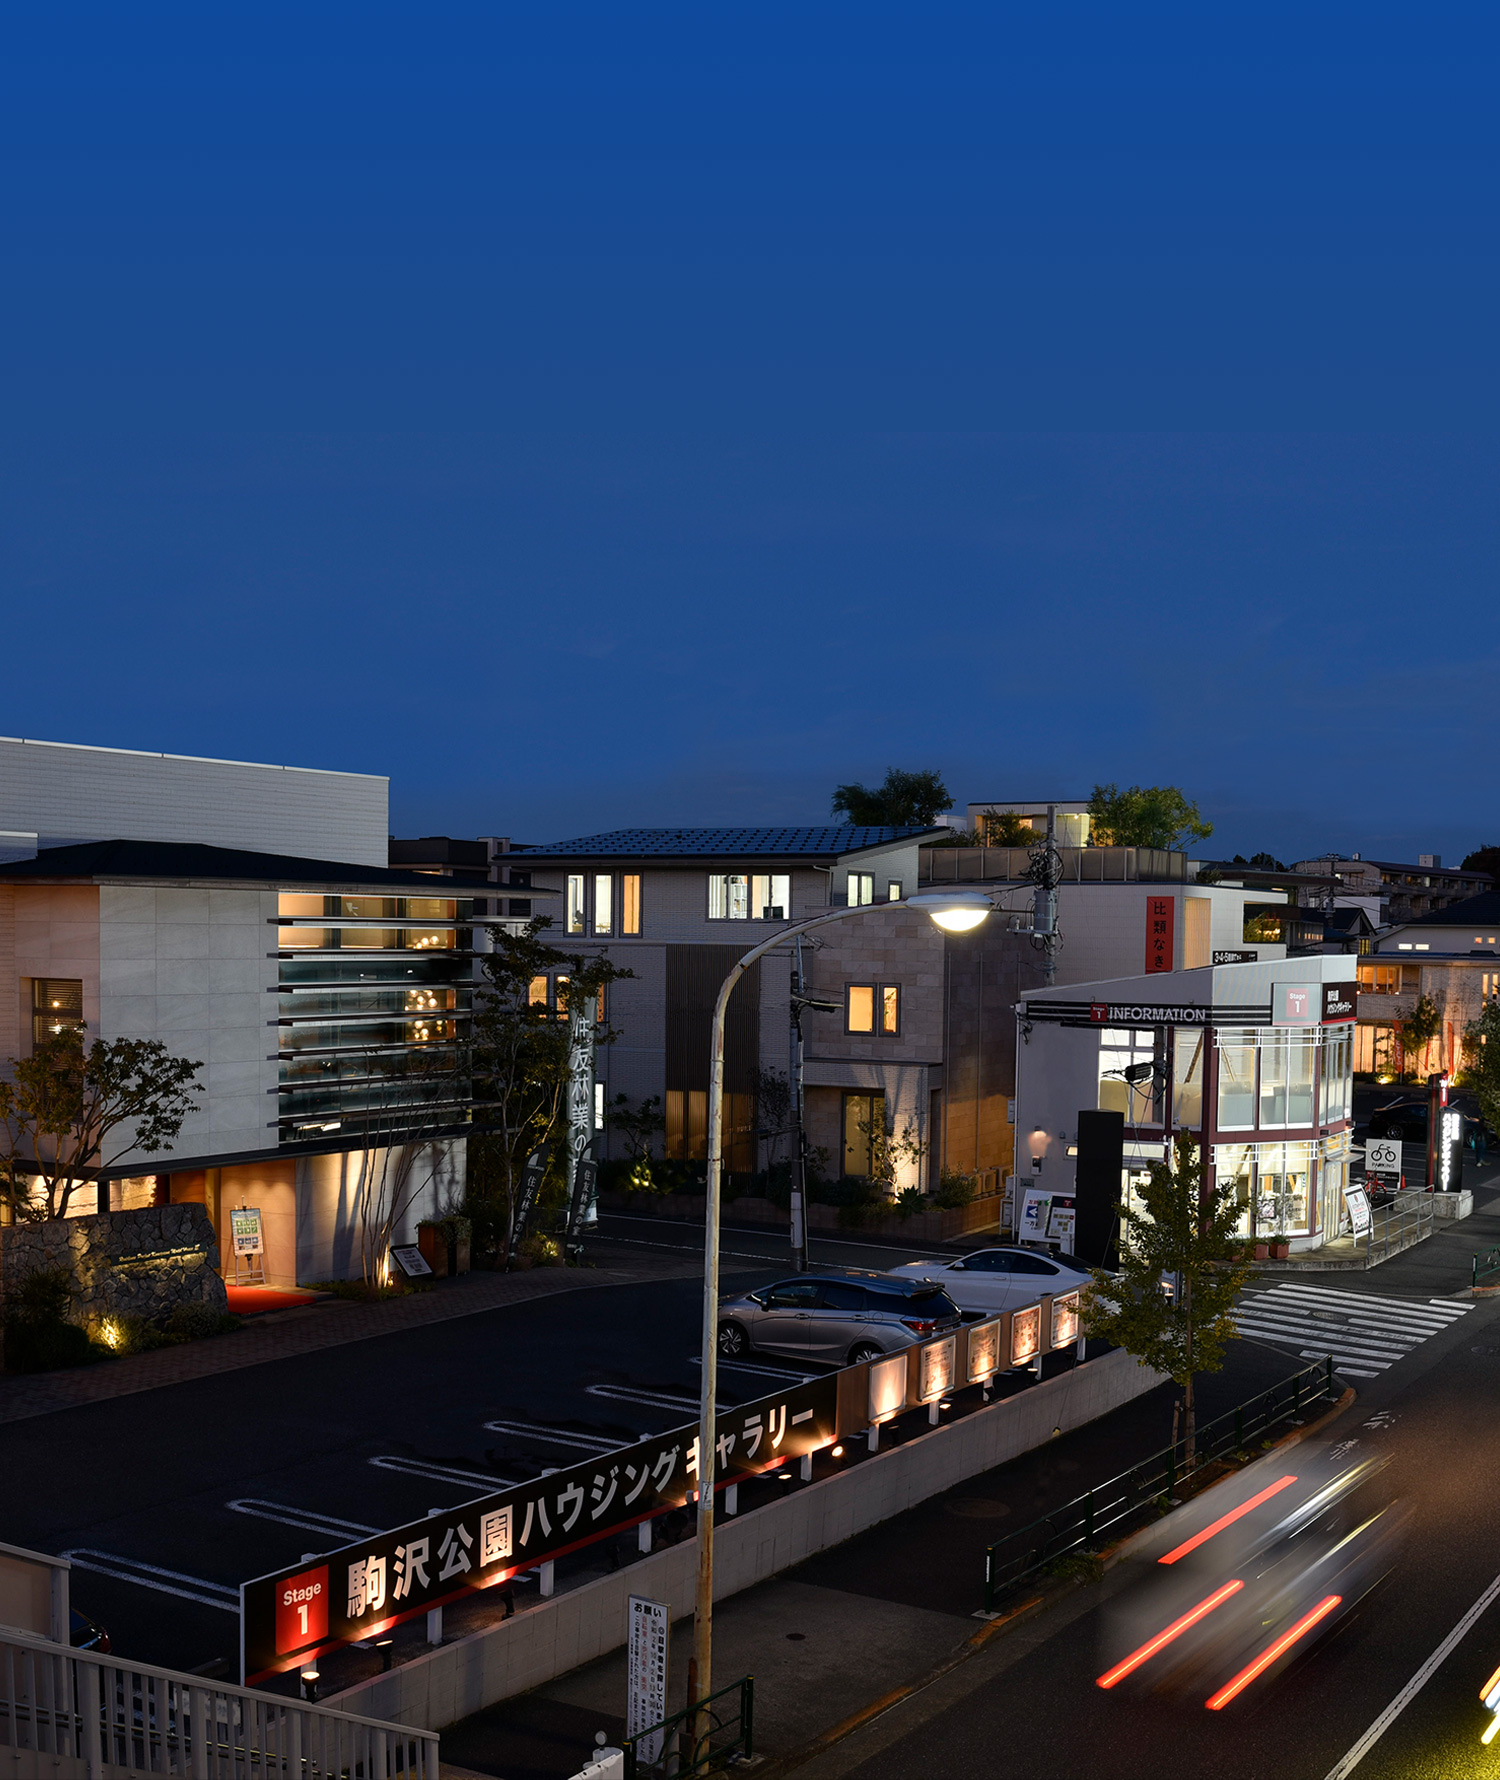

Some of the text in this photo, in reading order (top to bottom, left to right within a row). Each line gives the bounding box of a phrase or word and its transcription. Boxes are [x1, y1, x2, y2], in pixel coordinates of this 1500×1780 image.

[1153, 901, 1167, 968] 比類なき
[1289, 992, 1306, 1001] Stage
[1295, 1000, 1300, 1013] 1
[283, 1580, 321, 1607] Stage
[297, 1606, 308, 1635] 1
[634, 1602, 662, 1618] お願い
